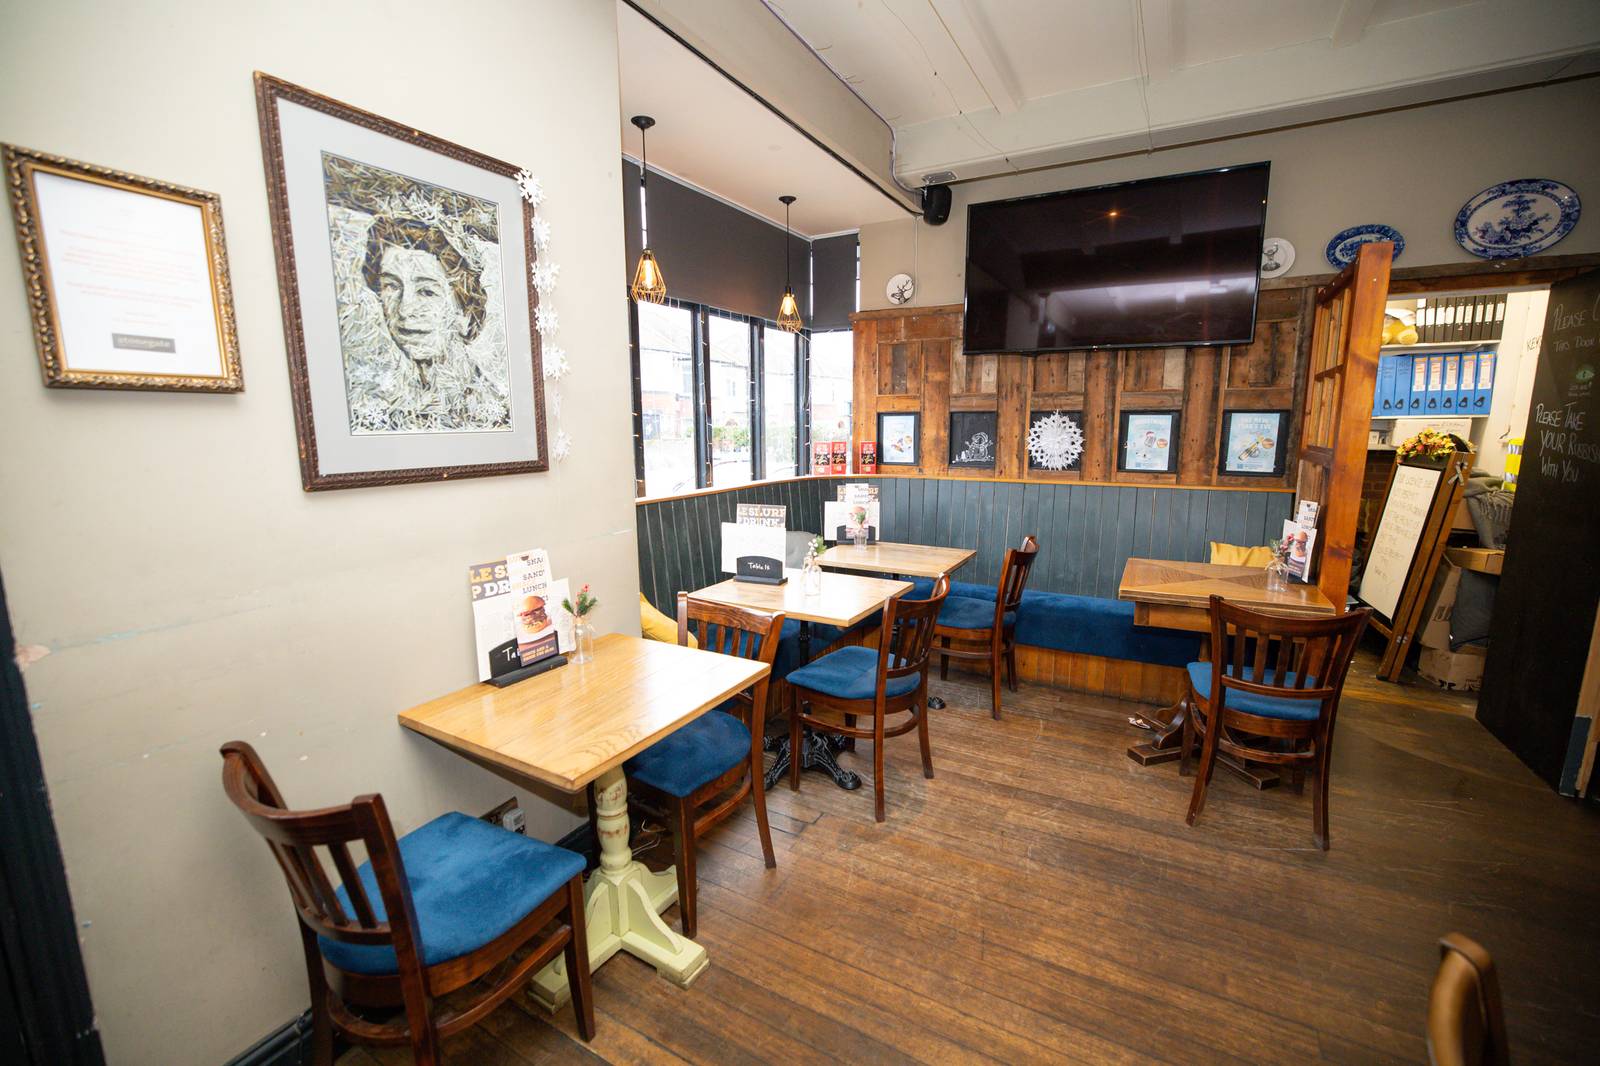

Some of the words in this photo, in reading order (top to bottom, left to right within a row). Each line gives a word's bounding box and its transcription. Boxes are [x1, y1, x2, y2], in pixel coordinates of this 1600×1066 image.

[1552, 303, 1586, 333] PLEASE
[1535, 403, 1563, 427] PLEASE
[1563, 401, 1586, 431] TAKE
[1539, 429, 1566, 456] YOUR
[1541, 455, 1559, 480] WITH
[1561, 459, 1579, 483] YOU
[522, 569, 545, 580] SAND
[747, 562, 763, 570] Table
[522, 583, 547, 595] LUNCH
